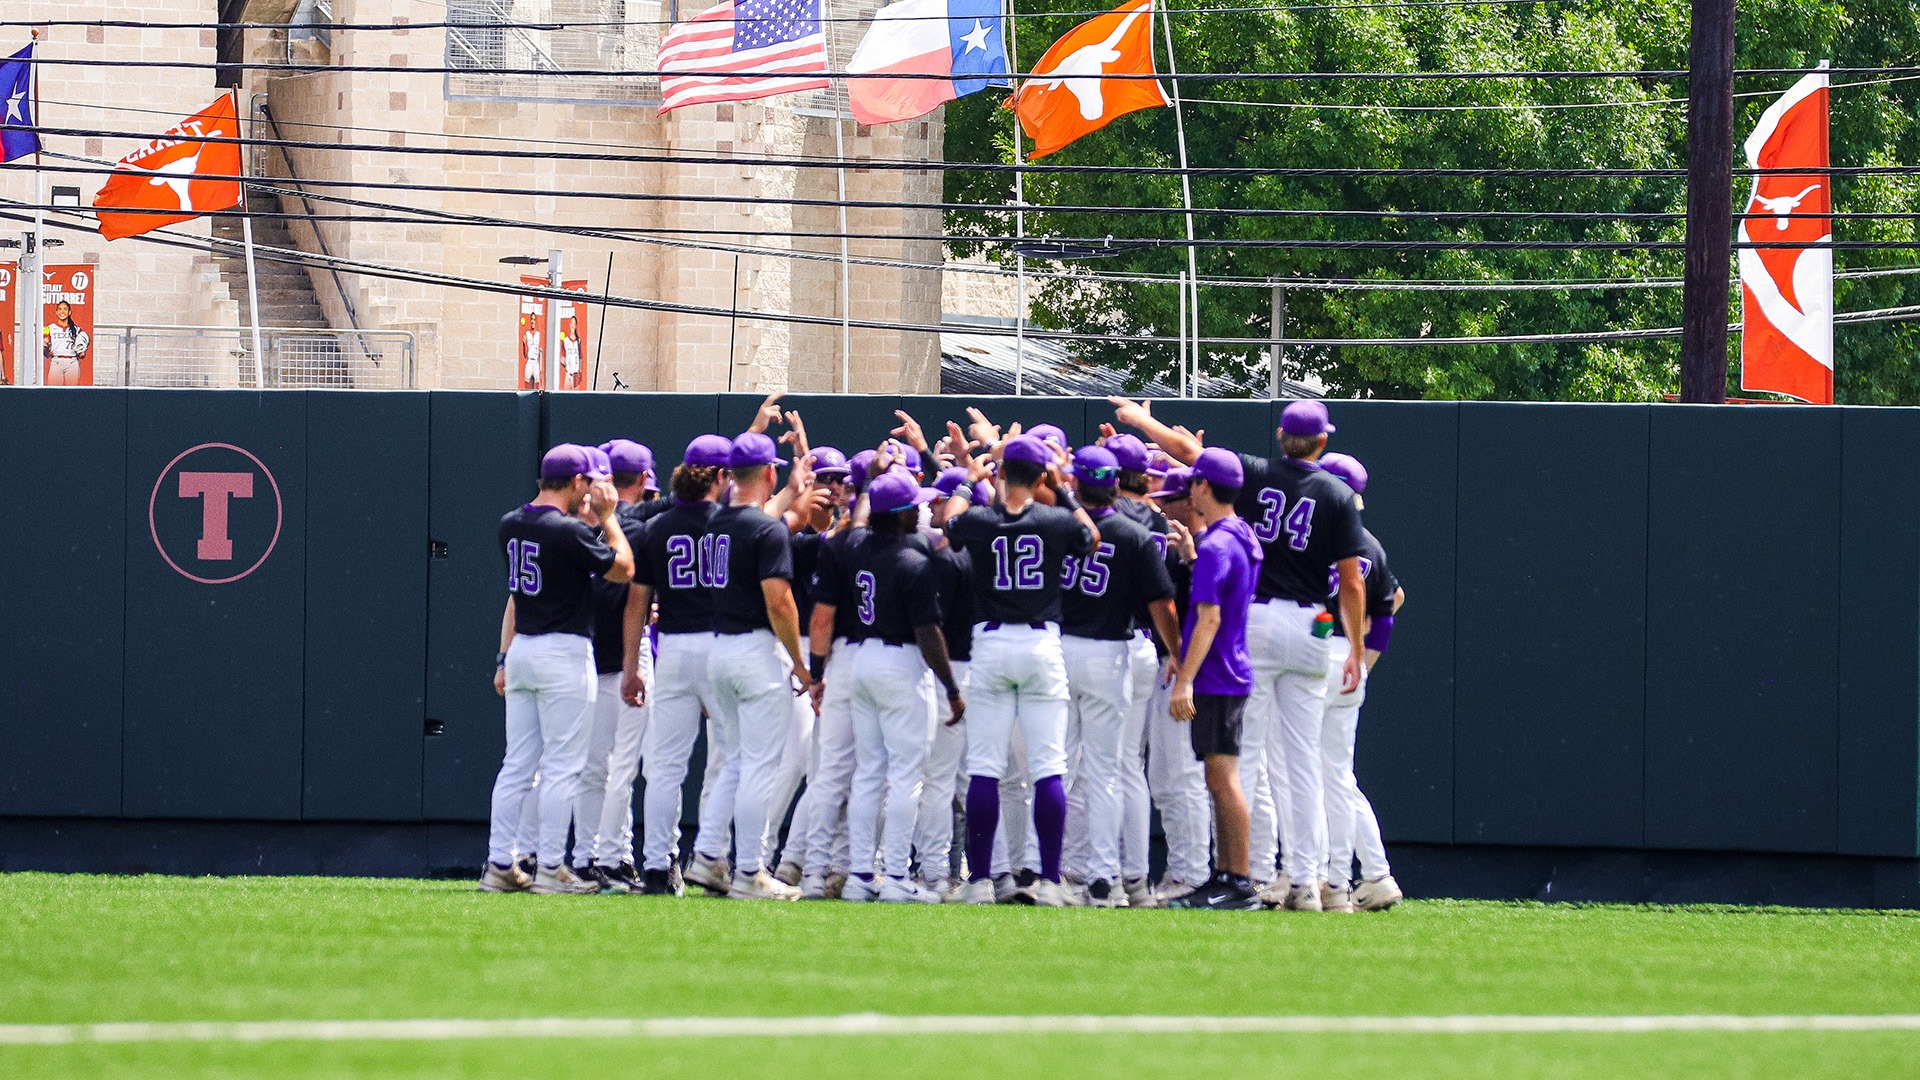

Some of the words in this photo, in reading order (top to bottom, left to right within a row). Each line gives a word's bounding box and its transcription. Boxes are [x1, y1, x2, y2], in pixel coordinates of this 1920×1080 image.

[75, 275, 85, 287] 77
[178, 471, 254, 561] T
[1253, 486, 1317, 551] 34
[507, 537, 543, 597] 15
[991, 534, 1045, 591] 12
[855, 569, 877, 626] 3
